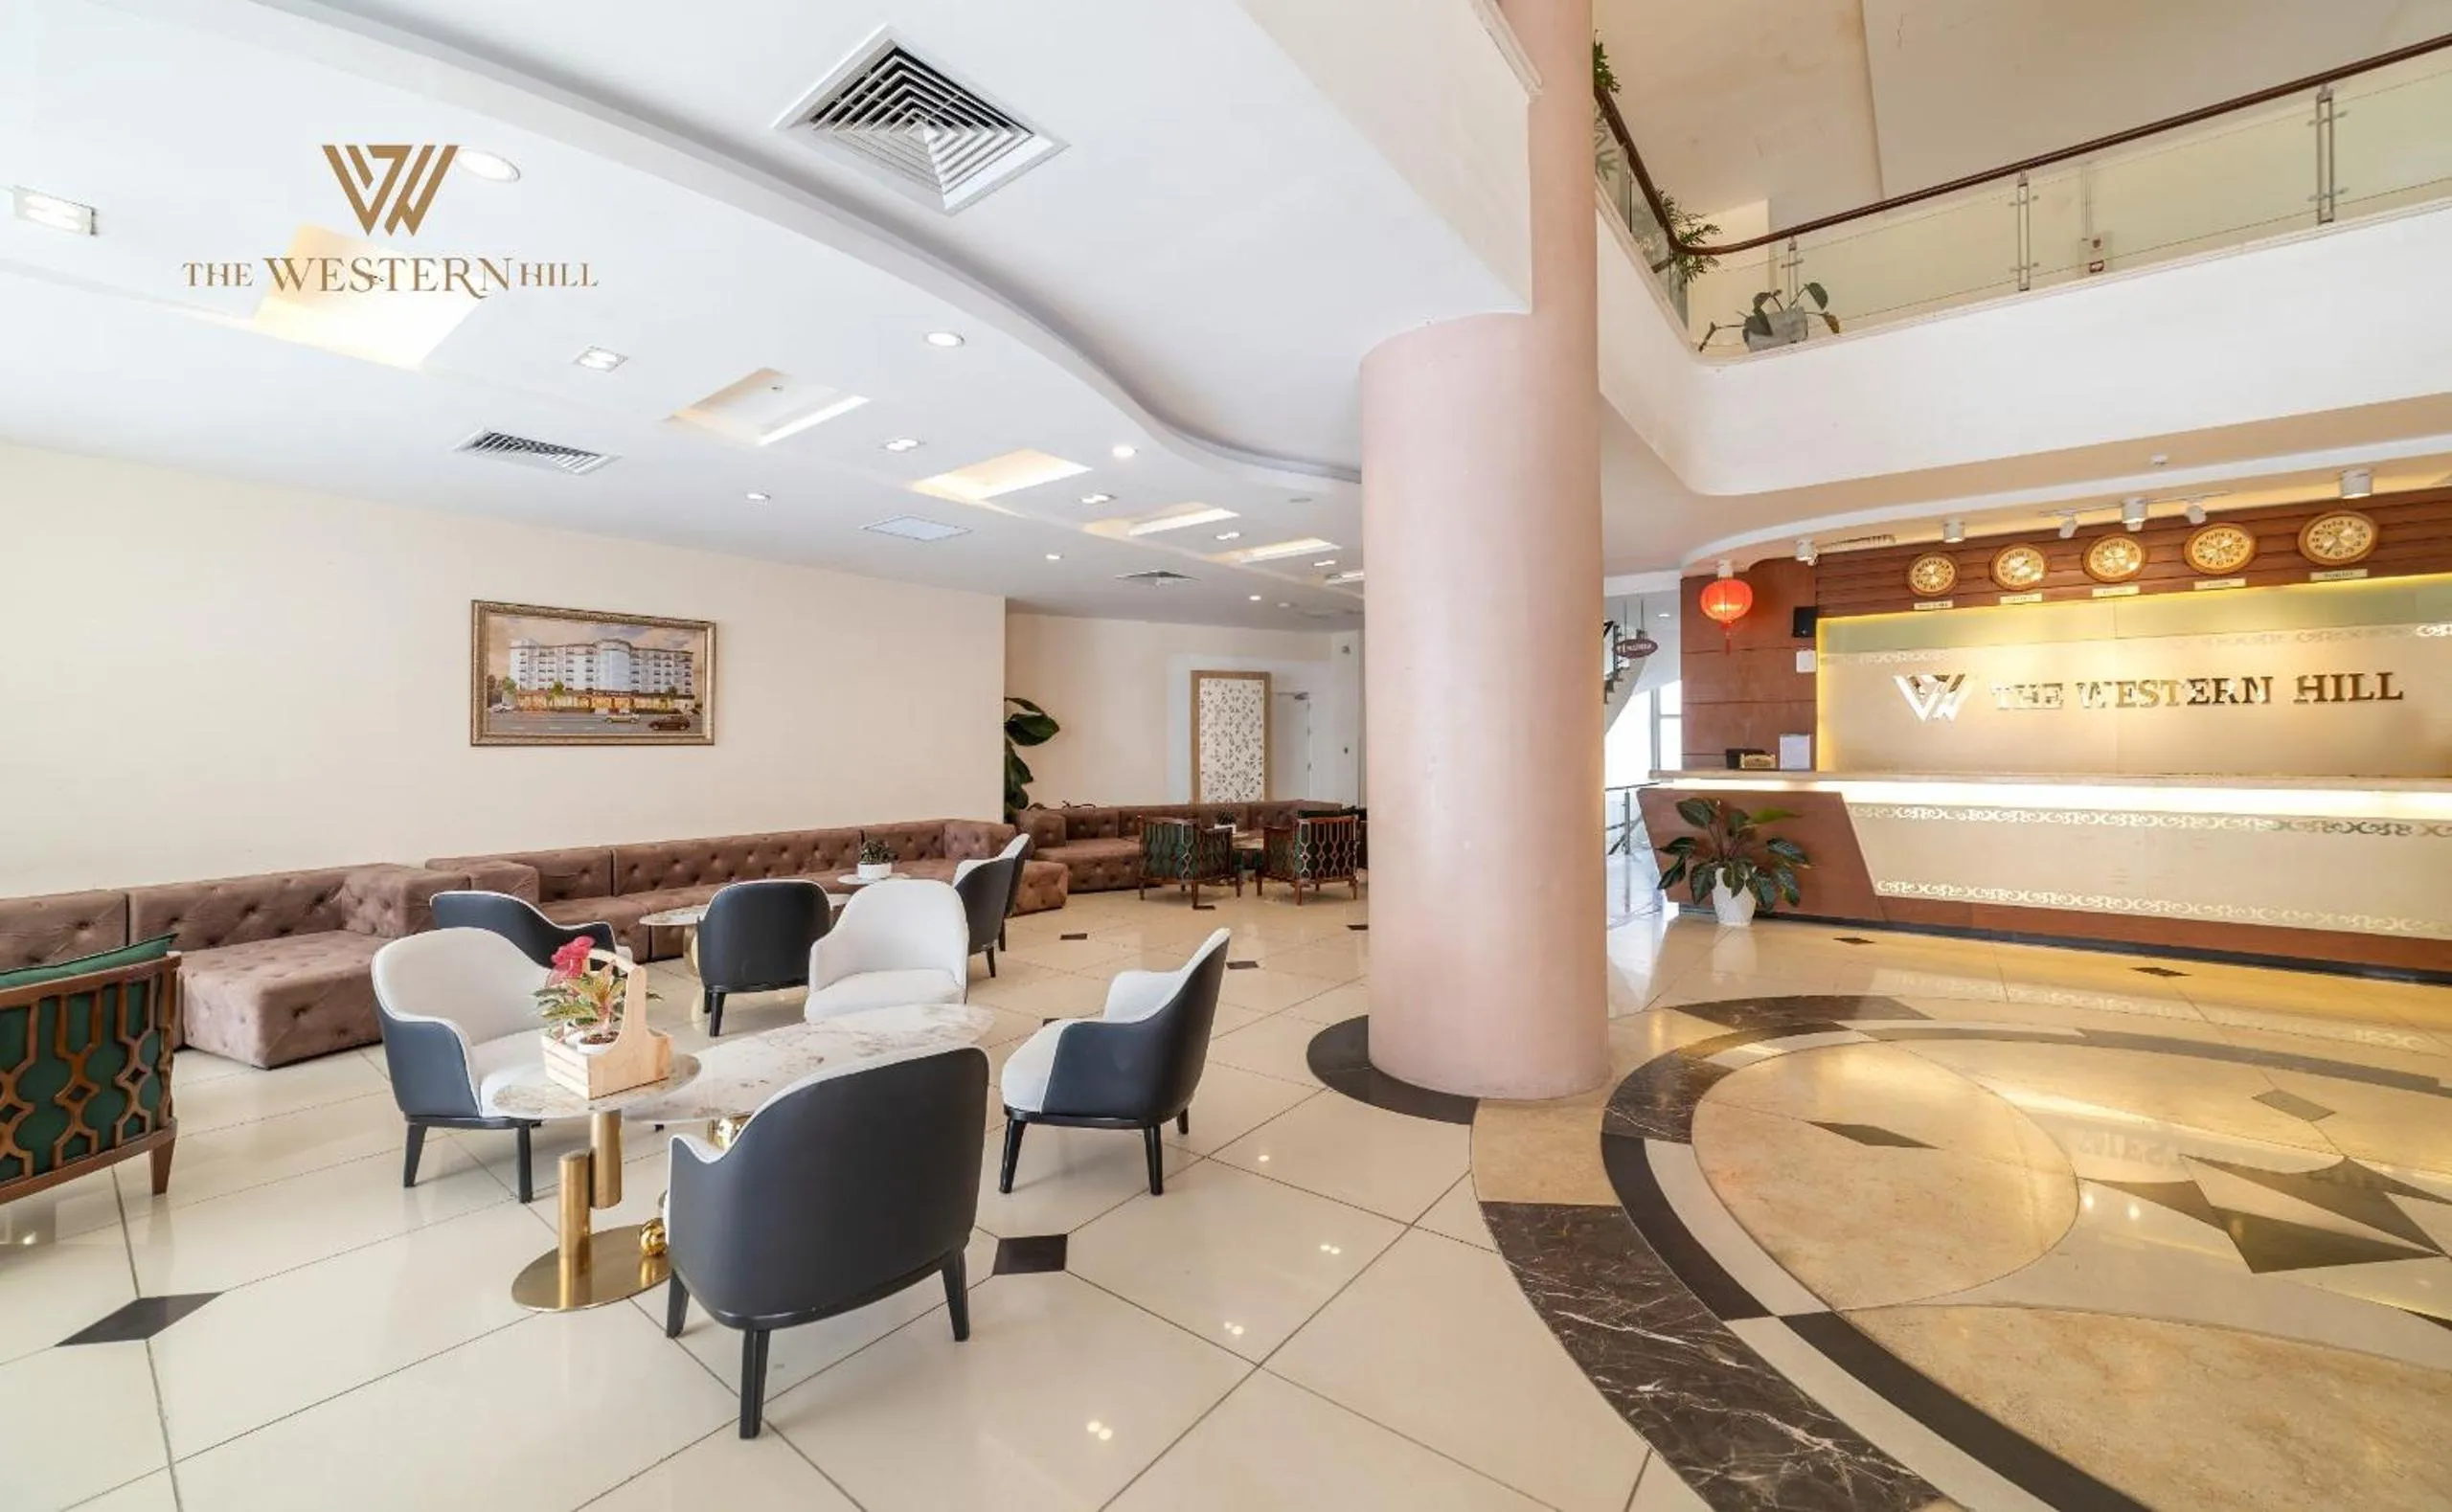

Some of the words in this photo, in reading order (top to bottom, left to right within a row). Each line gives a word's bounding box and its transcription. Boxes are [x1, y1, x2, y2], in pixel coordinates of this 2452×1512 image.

[1991, 682, 2064, 710] THE
[2076, 676, 2273, 709] WESTERN
[2294, 672, 2404, 704] HILL
